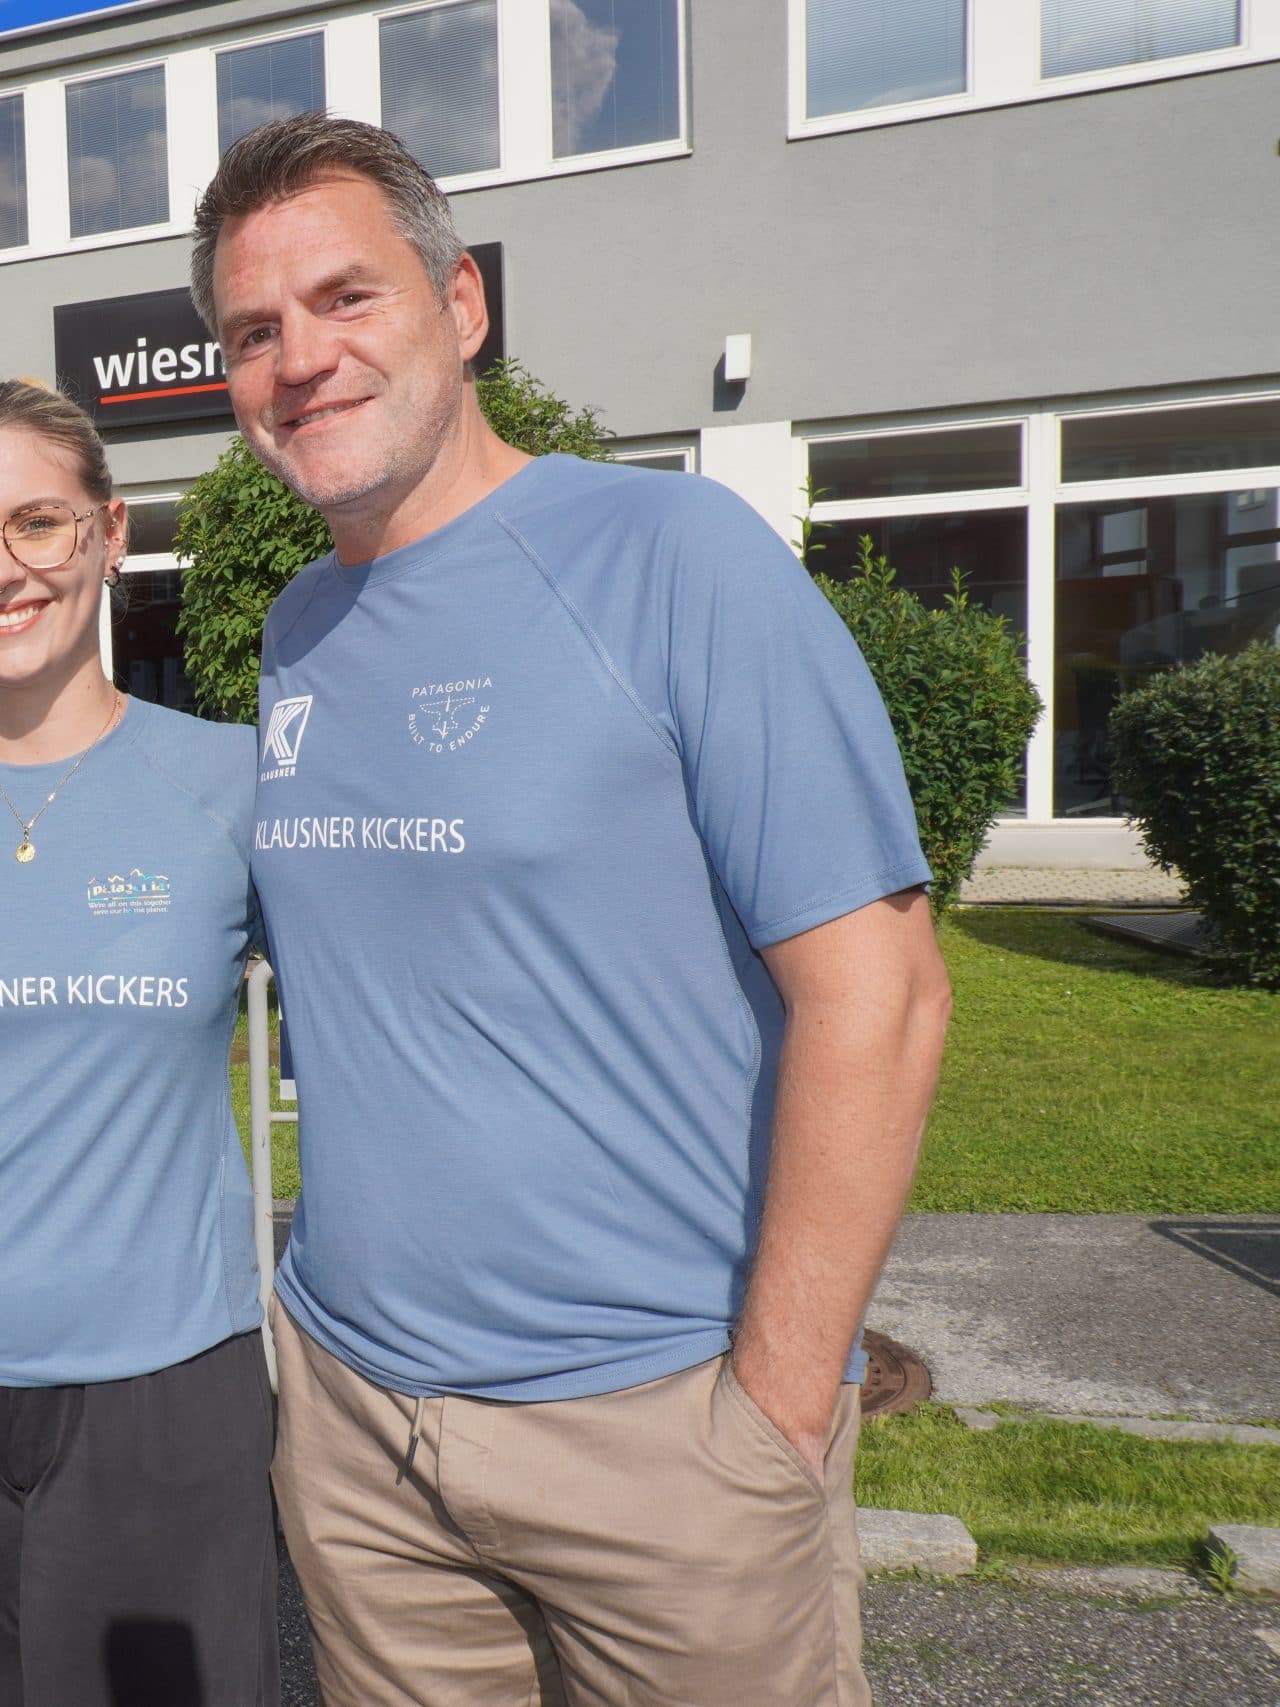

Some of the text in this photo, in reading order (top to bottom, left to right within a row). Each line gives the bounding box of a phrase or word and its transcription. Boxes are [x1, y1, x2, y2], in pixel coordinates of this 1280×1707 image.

[412, 677, 493, 698] PATAGONIA
[408, 705, 490, 753] BUILT TO ENDURE
[256, 816, 466, 853] KLAUSNER KICKERS
[67, 974, 189, 1008] KICKERS
